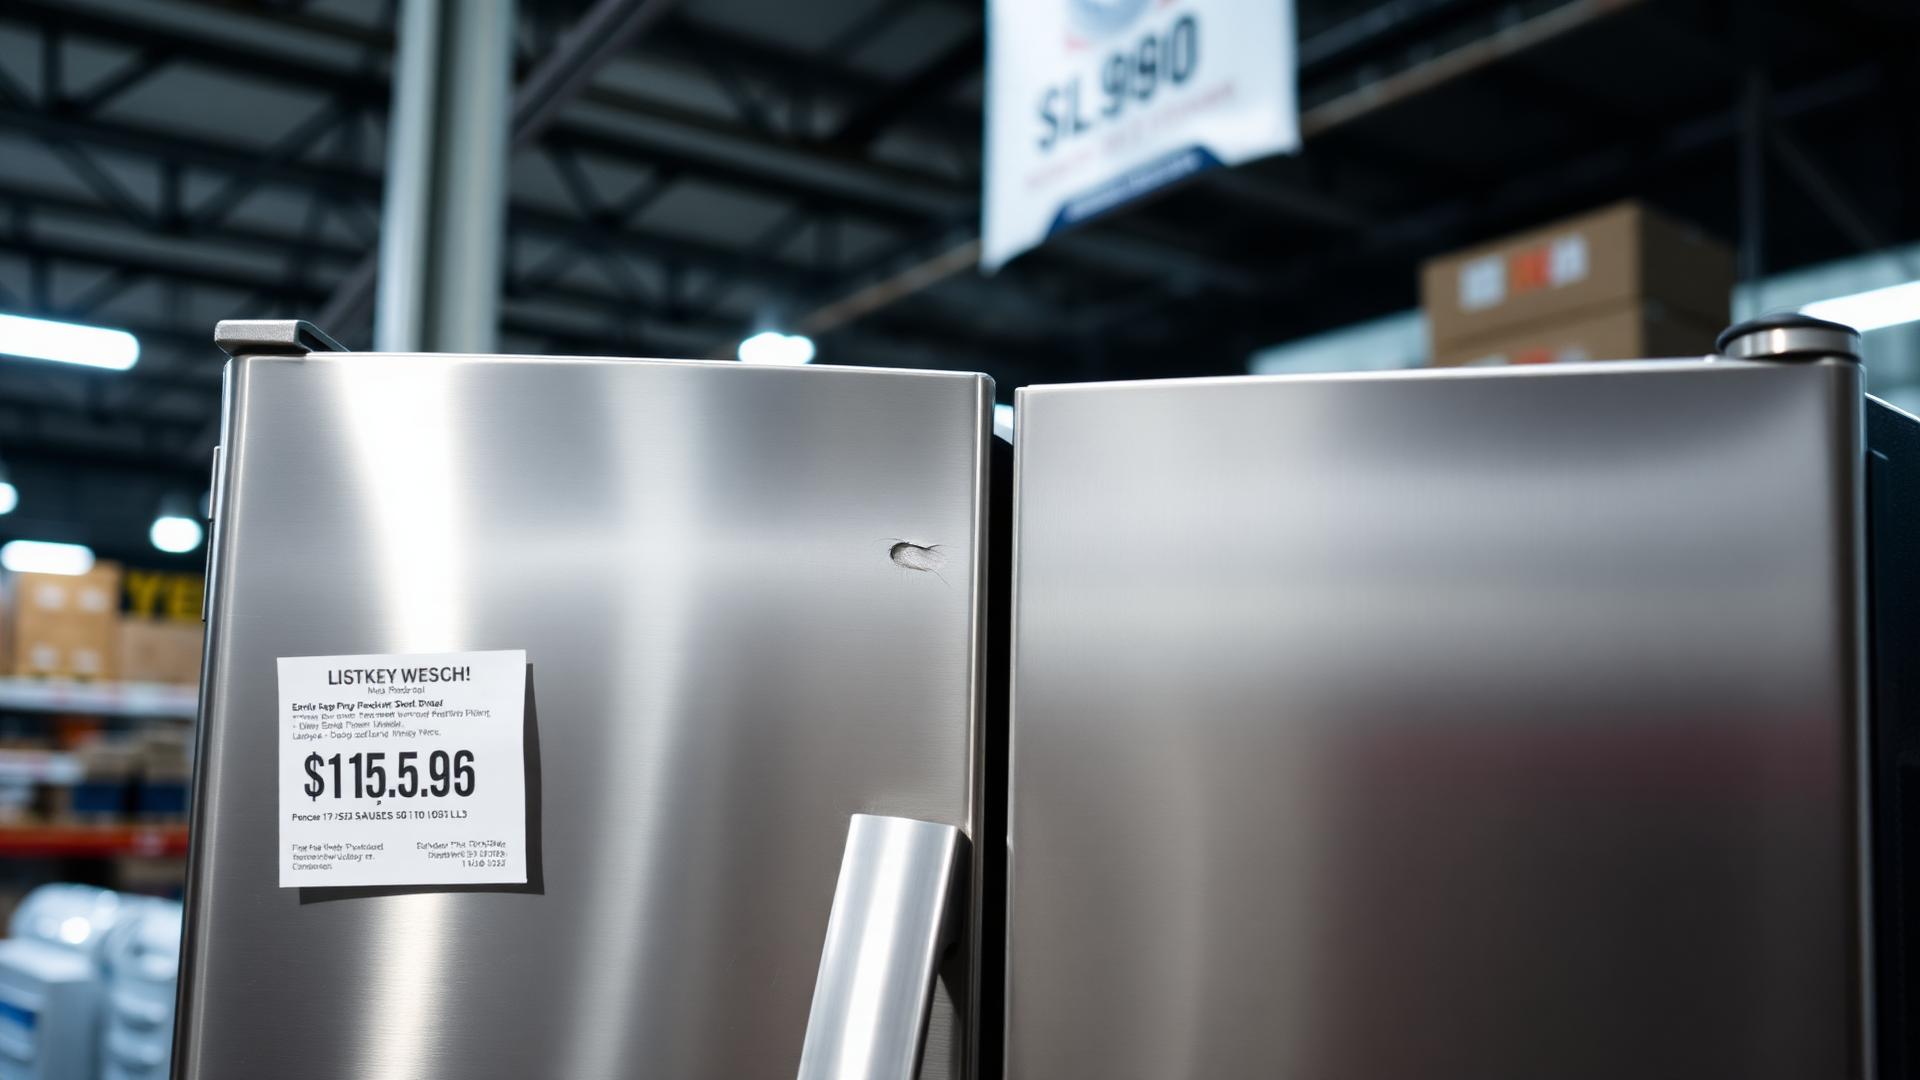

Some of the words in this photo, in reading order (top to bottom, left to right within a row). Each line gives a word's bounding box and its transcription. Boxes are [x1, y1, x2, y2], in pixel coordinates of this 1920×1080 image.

[328, 669, 398, 685] LISTKEY
[401, 666, 470, 683] WESCH!
[304, 749, 475, 802] $115.5.96
